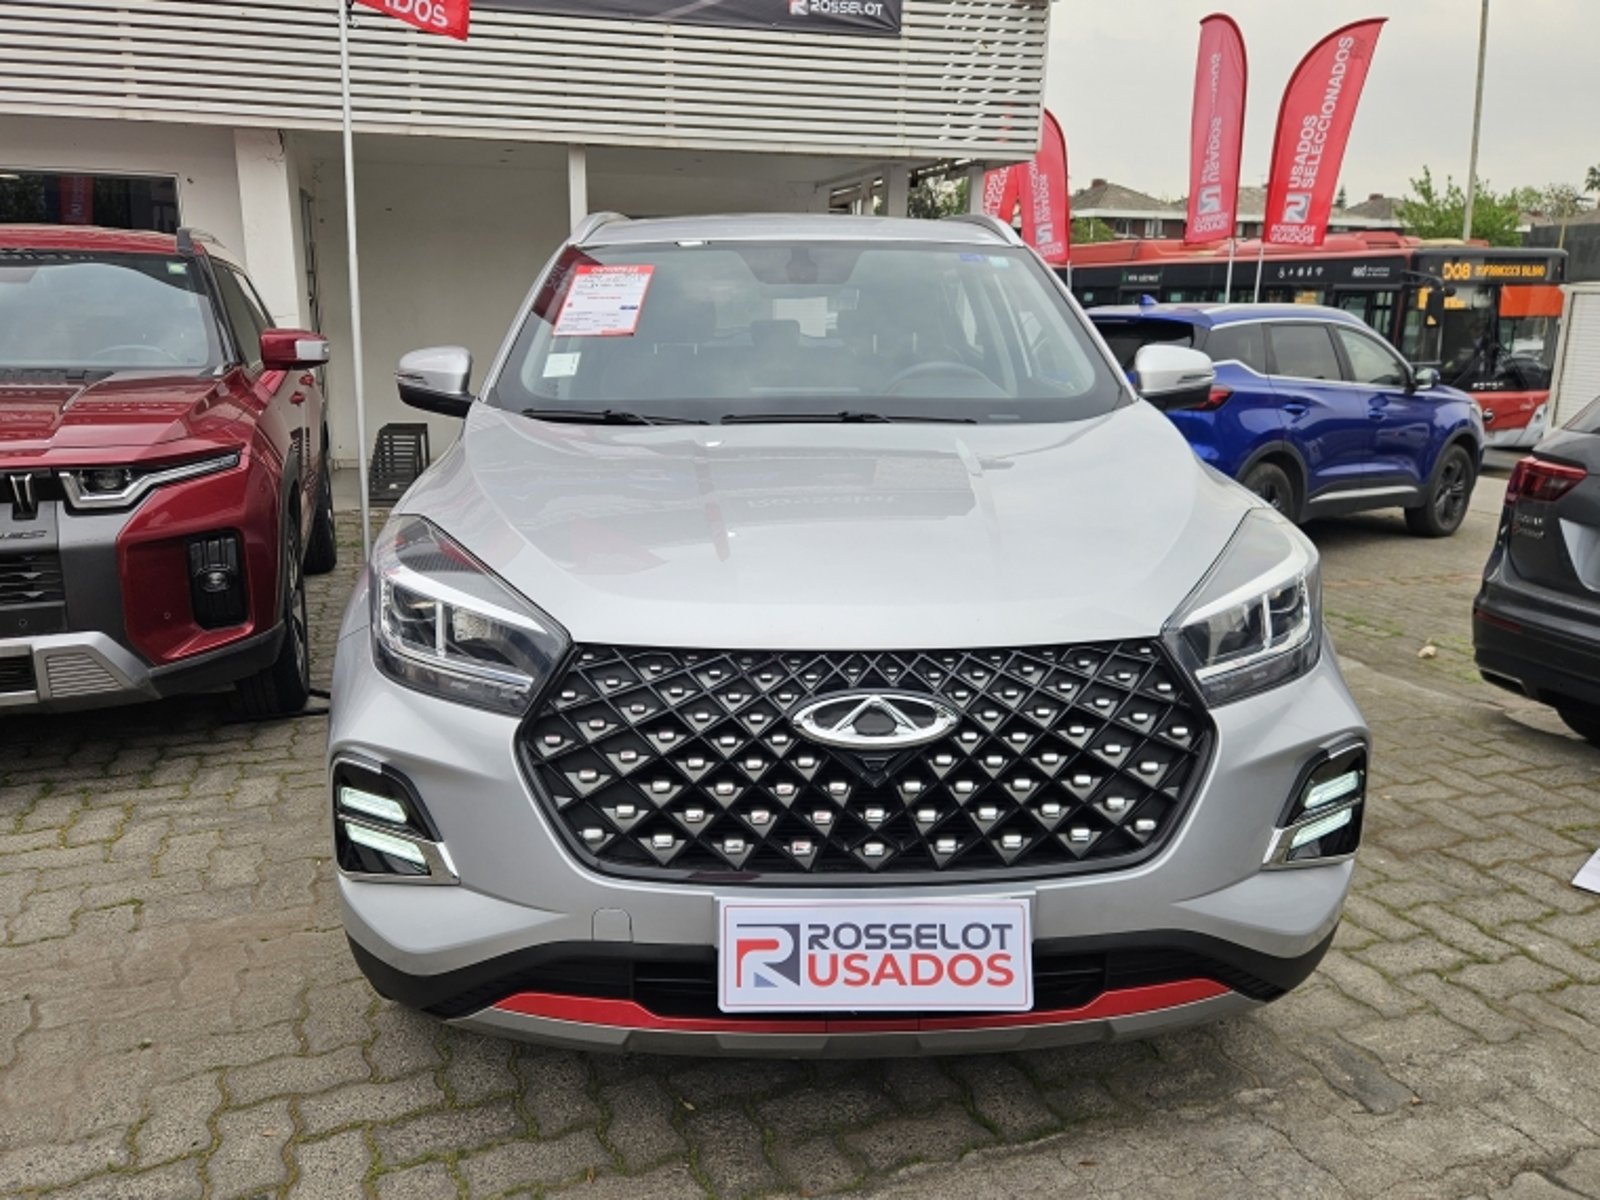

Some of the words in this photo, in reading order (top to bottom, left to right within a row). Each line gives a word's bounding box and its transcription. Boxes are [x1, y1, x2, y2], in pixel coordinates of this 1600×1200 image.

[1302, 36, 1354, 188] SELECCIONADOS
[1289, 115, 1318, 188] USADOS
[807, 923, 1013, 950] ROSSELOT
[807, 953, 1014, 988] USADOS
